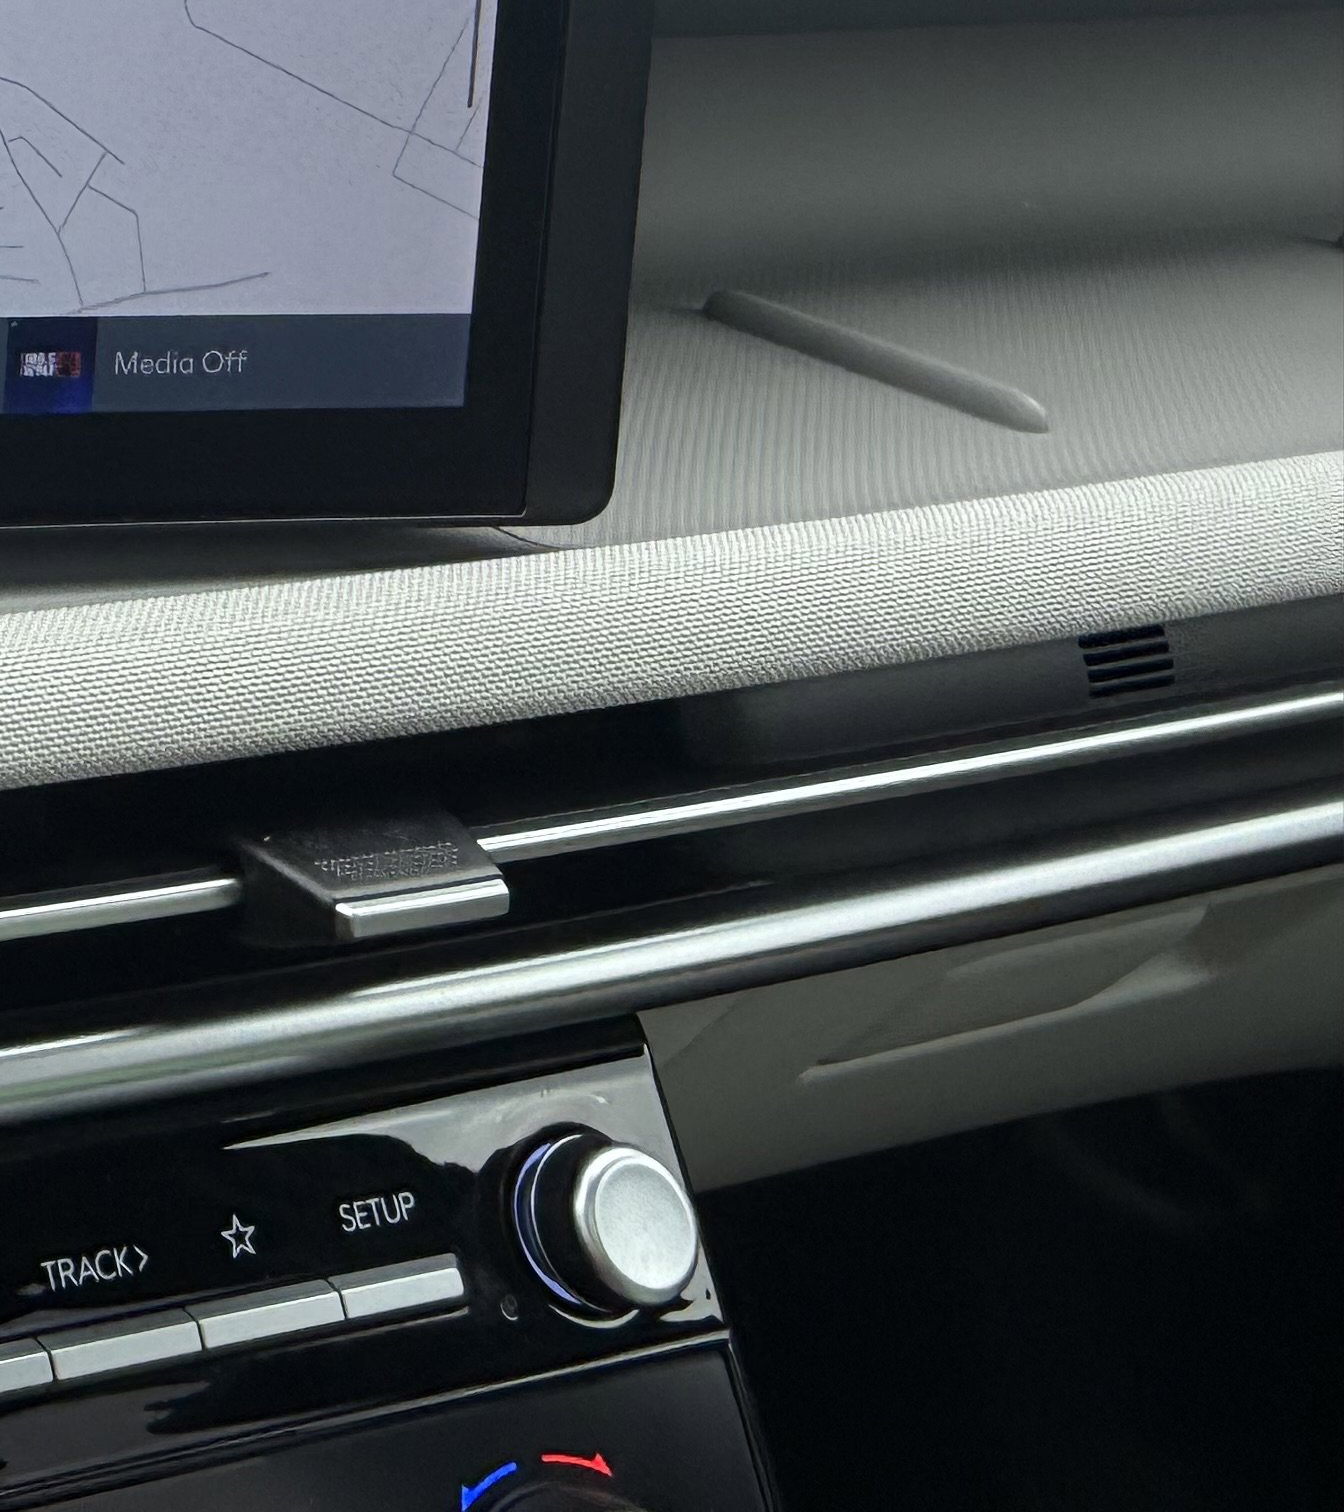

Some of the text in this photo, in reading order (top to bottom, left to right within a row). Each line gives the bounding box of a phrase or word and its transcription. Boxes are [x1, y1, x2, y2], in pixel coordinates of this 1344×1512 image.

[114, 349, 249, 376] Media Off
[338, 1190, 416, 1233] SETUP
